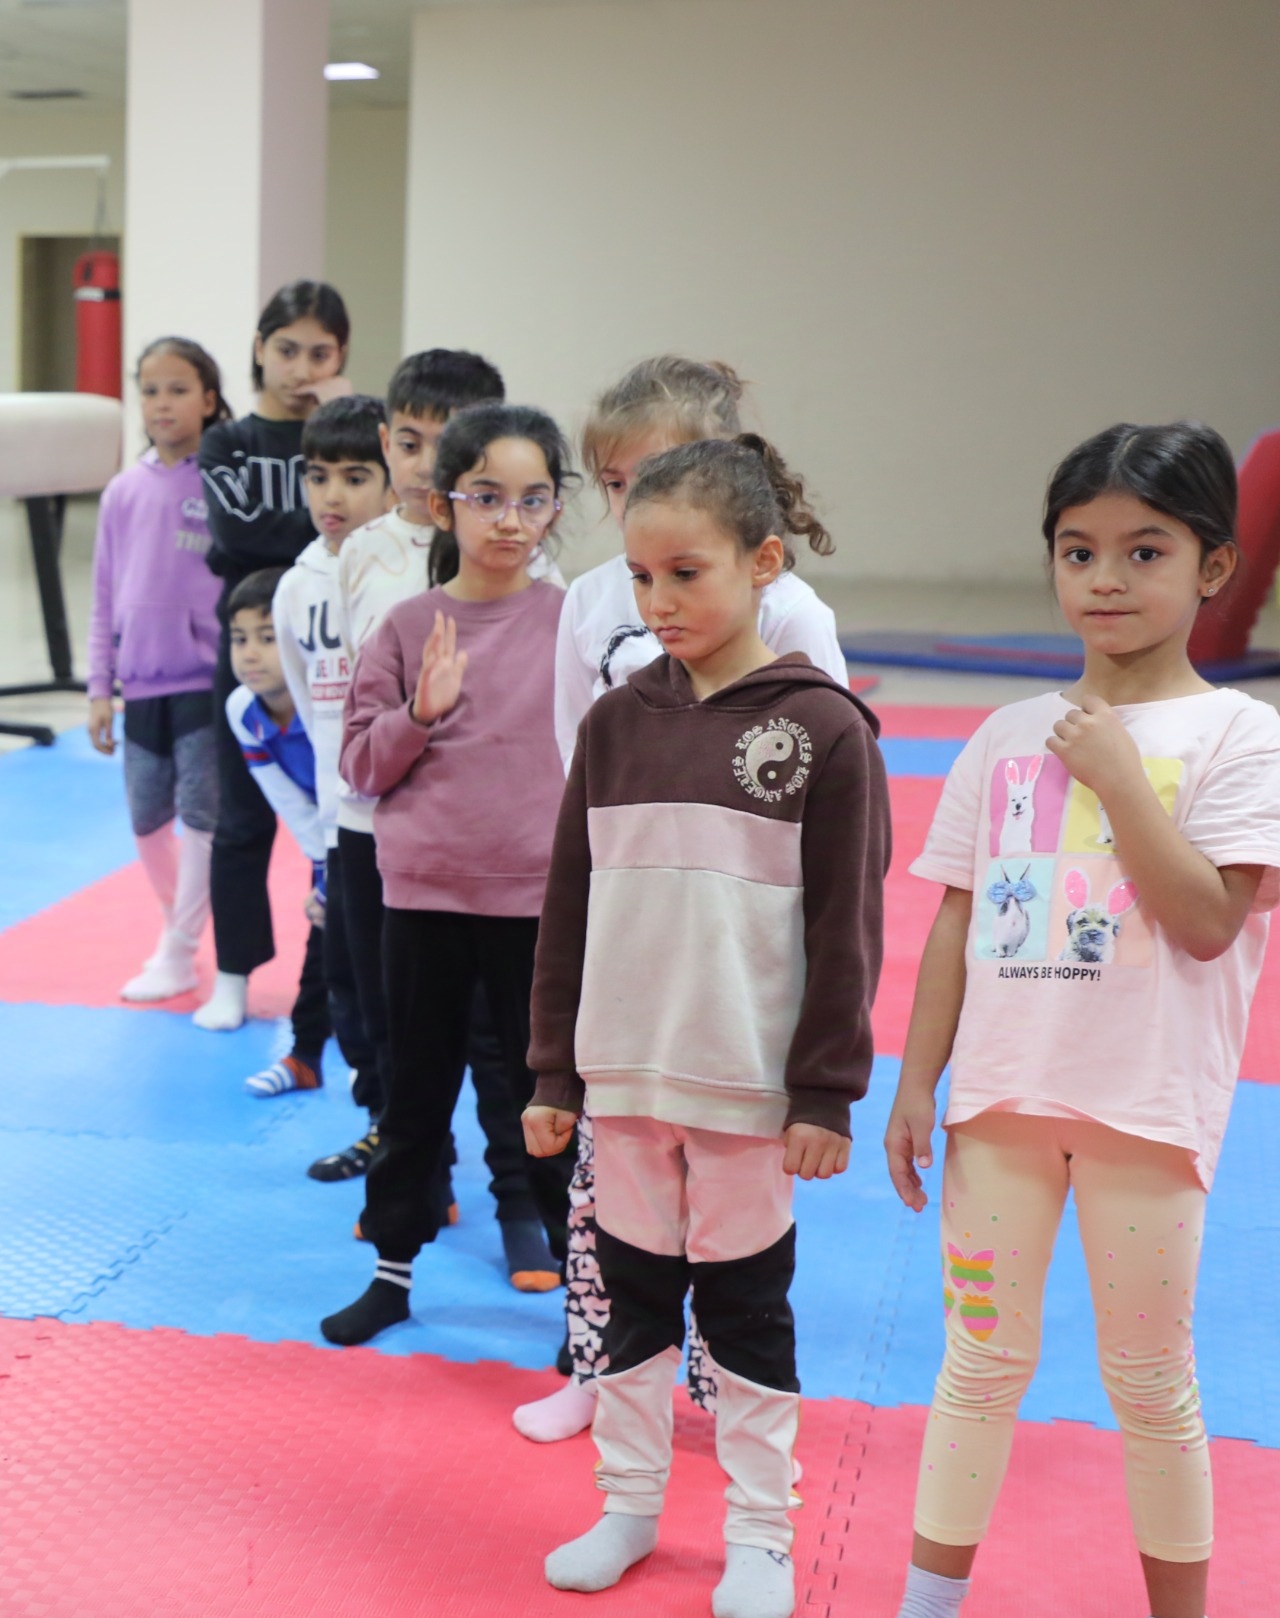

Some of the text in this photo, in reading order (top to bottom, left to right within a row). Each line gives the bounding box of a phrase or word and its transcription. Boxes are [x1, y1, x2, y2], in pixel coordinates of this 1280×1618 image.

[735, 717, 813, 763] LOS ANGELES
[732, 756, 782, 802] ANGELES
[785, 766, 810, 795] LOS
[998, 966, 1101, 981] ALWAYS BE HOPPY!
